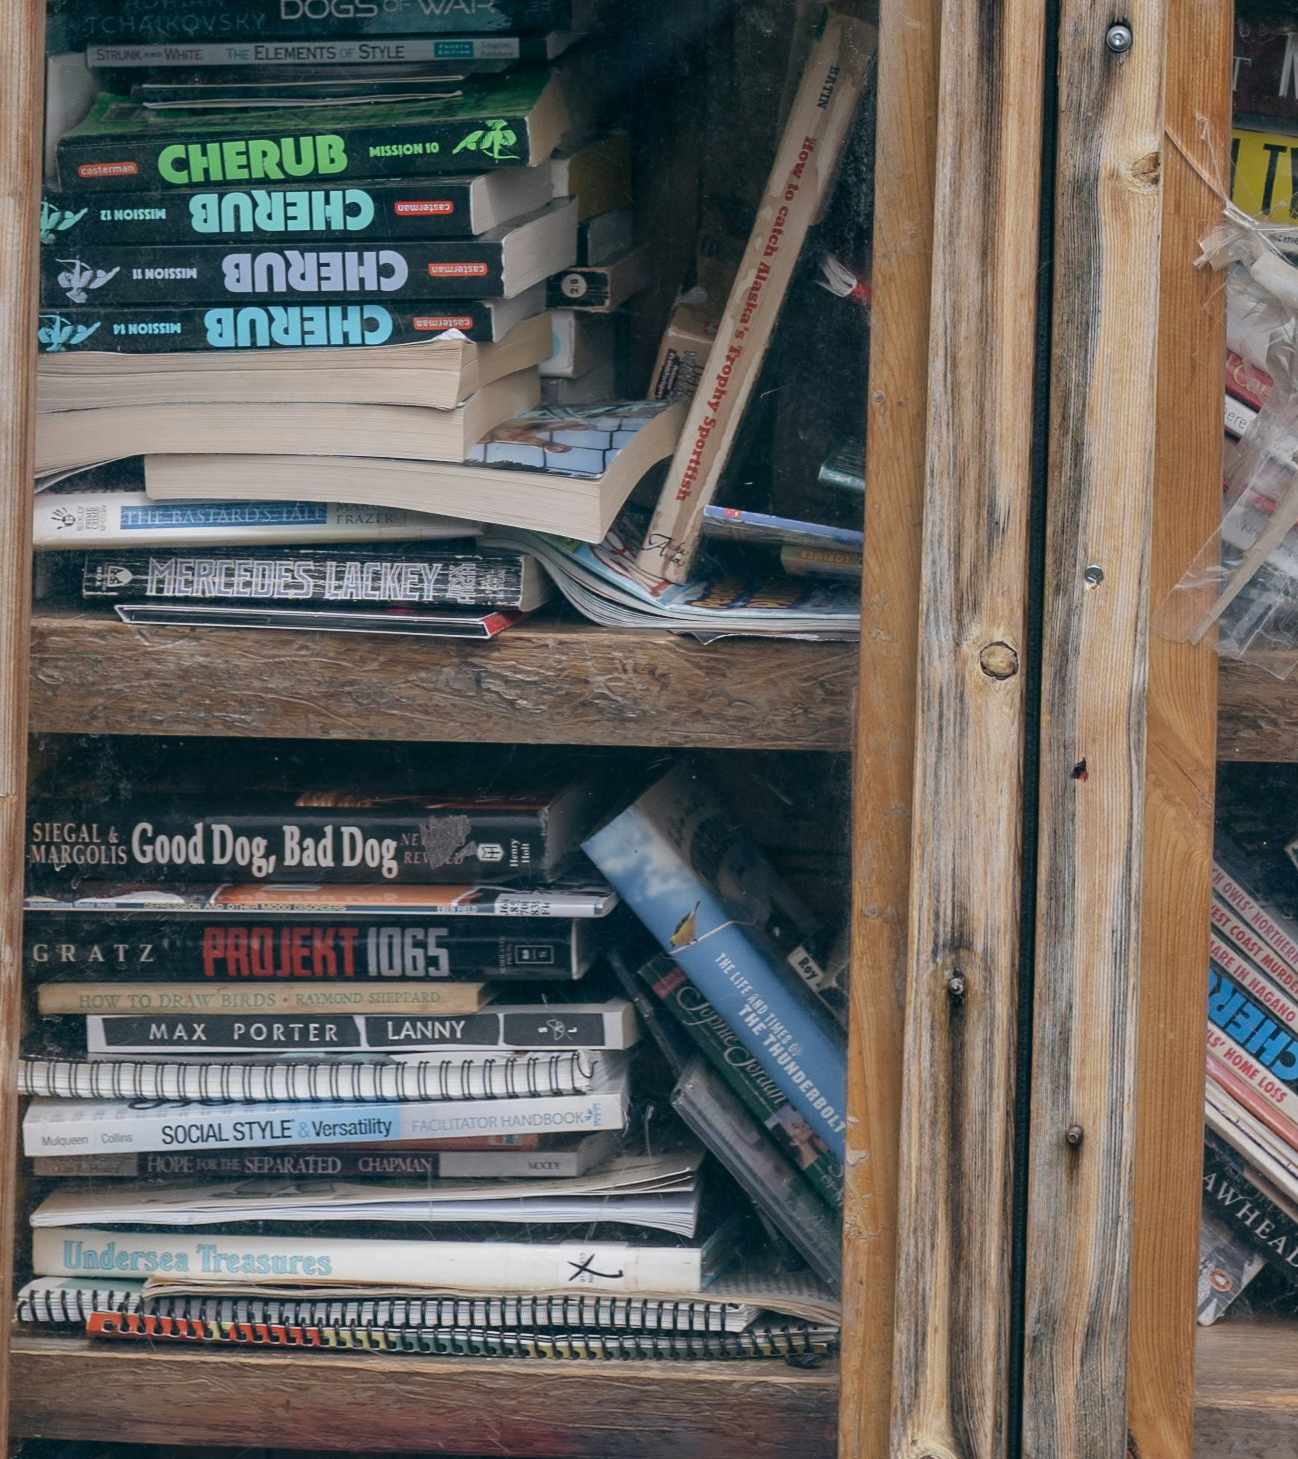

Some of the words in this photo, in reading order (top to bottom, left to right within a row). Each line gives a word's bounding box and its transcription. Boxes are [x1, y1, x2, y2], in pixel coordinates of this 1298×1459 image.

[157, 134, 349, 185] CHERUB
[187, 189, 375, 234] CHERUB
[222, 249, 409, 293] CHERUB
[203, 304, 393, 349] CHERUB
[146, 556, 314, 600] MERCEDES
[322, 561, 443, 602] LACKEY
[31, 843, 129, 866] MARGOLIS
[131, 822, 206, 865] Good
[211, 823, 278, 879] Dog,
[282, 825, 335, 869] Bad
[340, 825, 400, 879] Dog
[1221, 881, 1255, 913] OWLS'
[32, 943, 155, 963] GRATZ
[203, 926, 360, 978] PROJEKT
[366, 926, 450, 978] 1065
[1229, 925, 1264, 958] COAST
[79, 994, 122, 1009] HOW
[127, 994, 152, 1009] TO
[158, 993, 216, 1009] DRAW
[220, 992, 276, 1007] BIRDS
[294, 992, 364, 1005] RAYMOND
[368, 991, 441, 1004] SHEPPARD
[149, 1022, 207, 1042] MAX
[233, 1022, 339, 1043] PORTER
[387, 1020, 467, 1041] LANNY
[738, 1003, 767, 1036] THE
[762, 1034, 847, 1134] THUNDERBOLT
[1222, 1047, 1259, 1082] HOME
[1256, 1075, 1288, 1105] LOSS
[161, 1122, 229, 1146] SOCIAL
[232, 1119, 293, 1142] STYLE
[297, 1122, 311, 1138] &
[312, 1117, 393, 1138] Versatility
[411, 1115, 498, 1132] FACILITATOR
[500, 1110, 585, 1128] HANDBOOK
[62, 1239, 190, 1274] Undersea
[196, 1243, 333, 1278] Treasures
